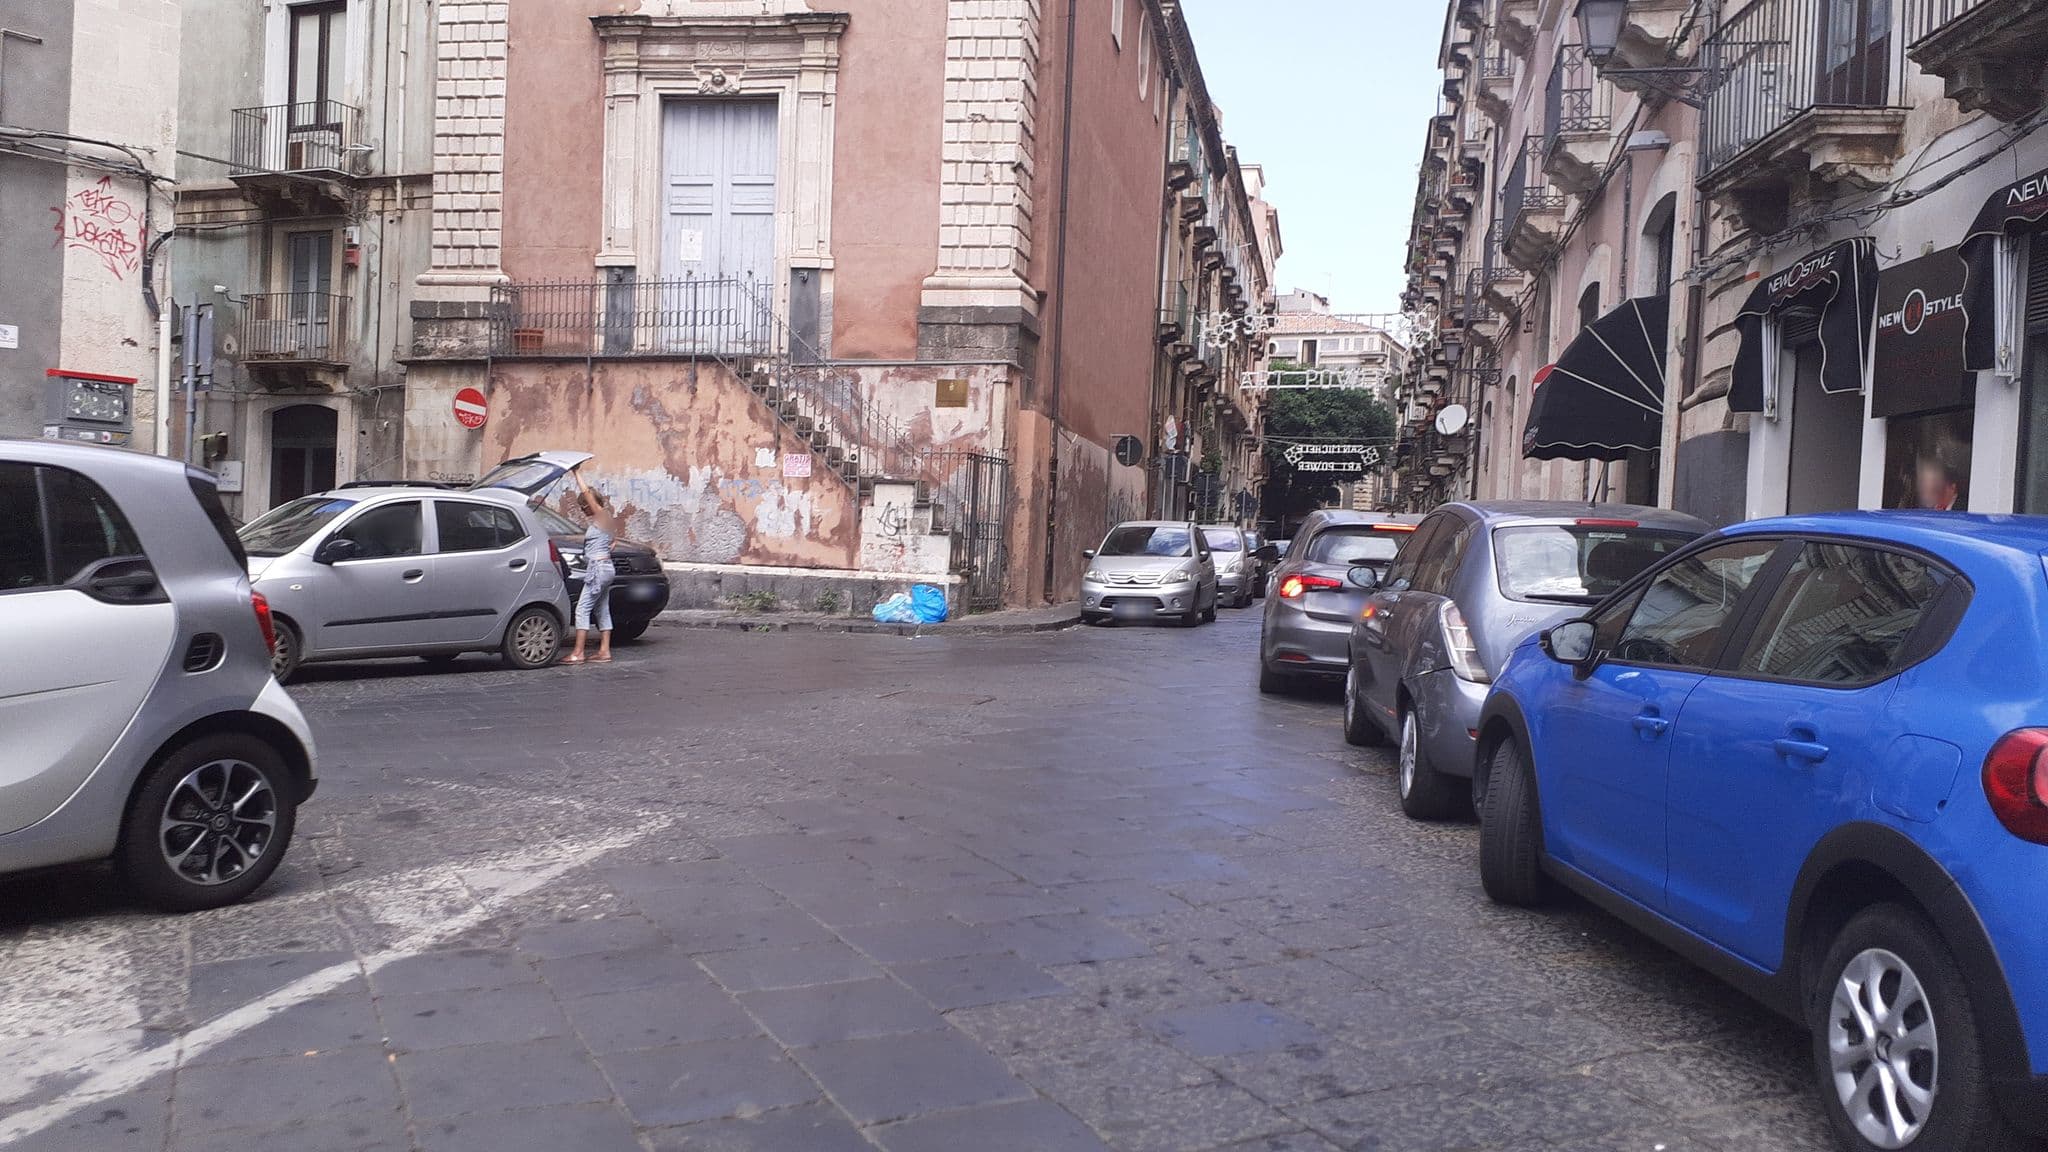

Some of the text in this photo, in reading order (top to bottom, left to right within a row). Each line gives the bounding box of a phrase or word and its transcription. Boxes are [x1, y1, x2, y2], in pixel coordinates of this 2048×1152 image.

[1768, 273, 1789, 296] NEW
[1801, 251, 1837, 278] STYLE
[1879, 294, 1962, 329] NEW STYLE
